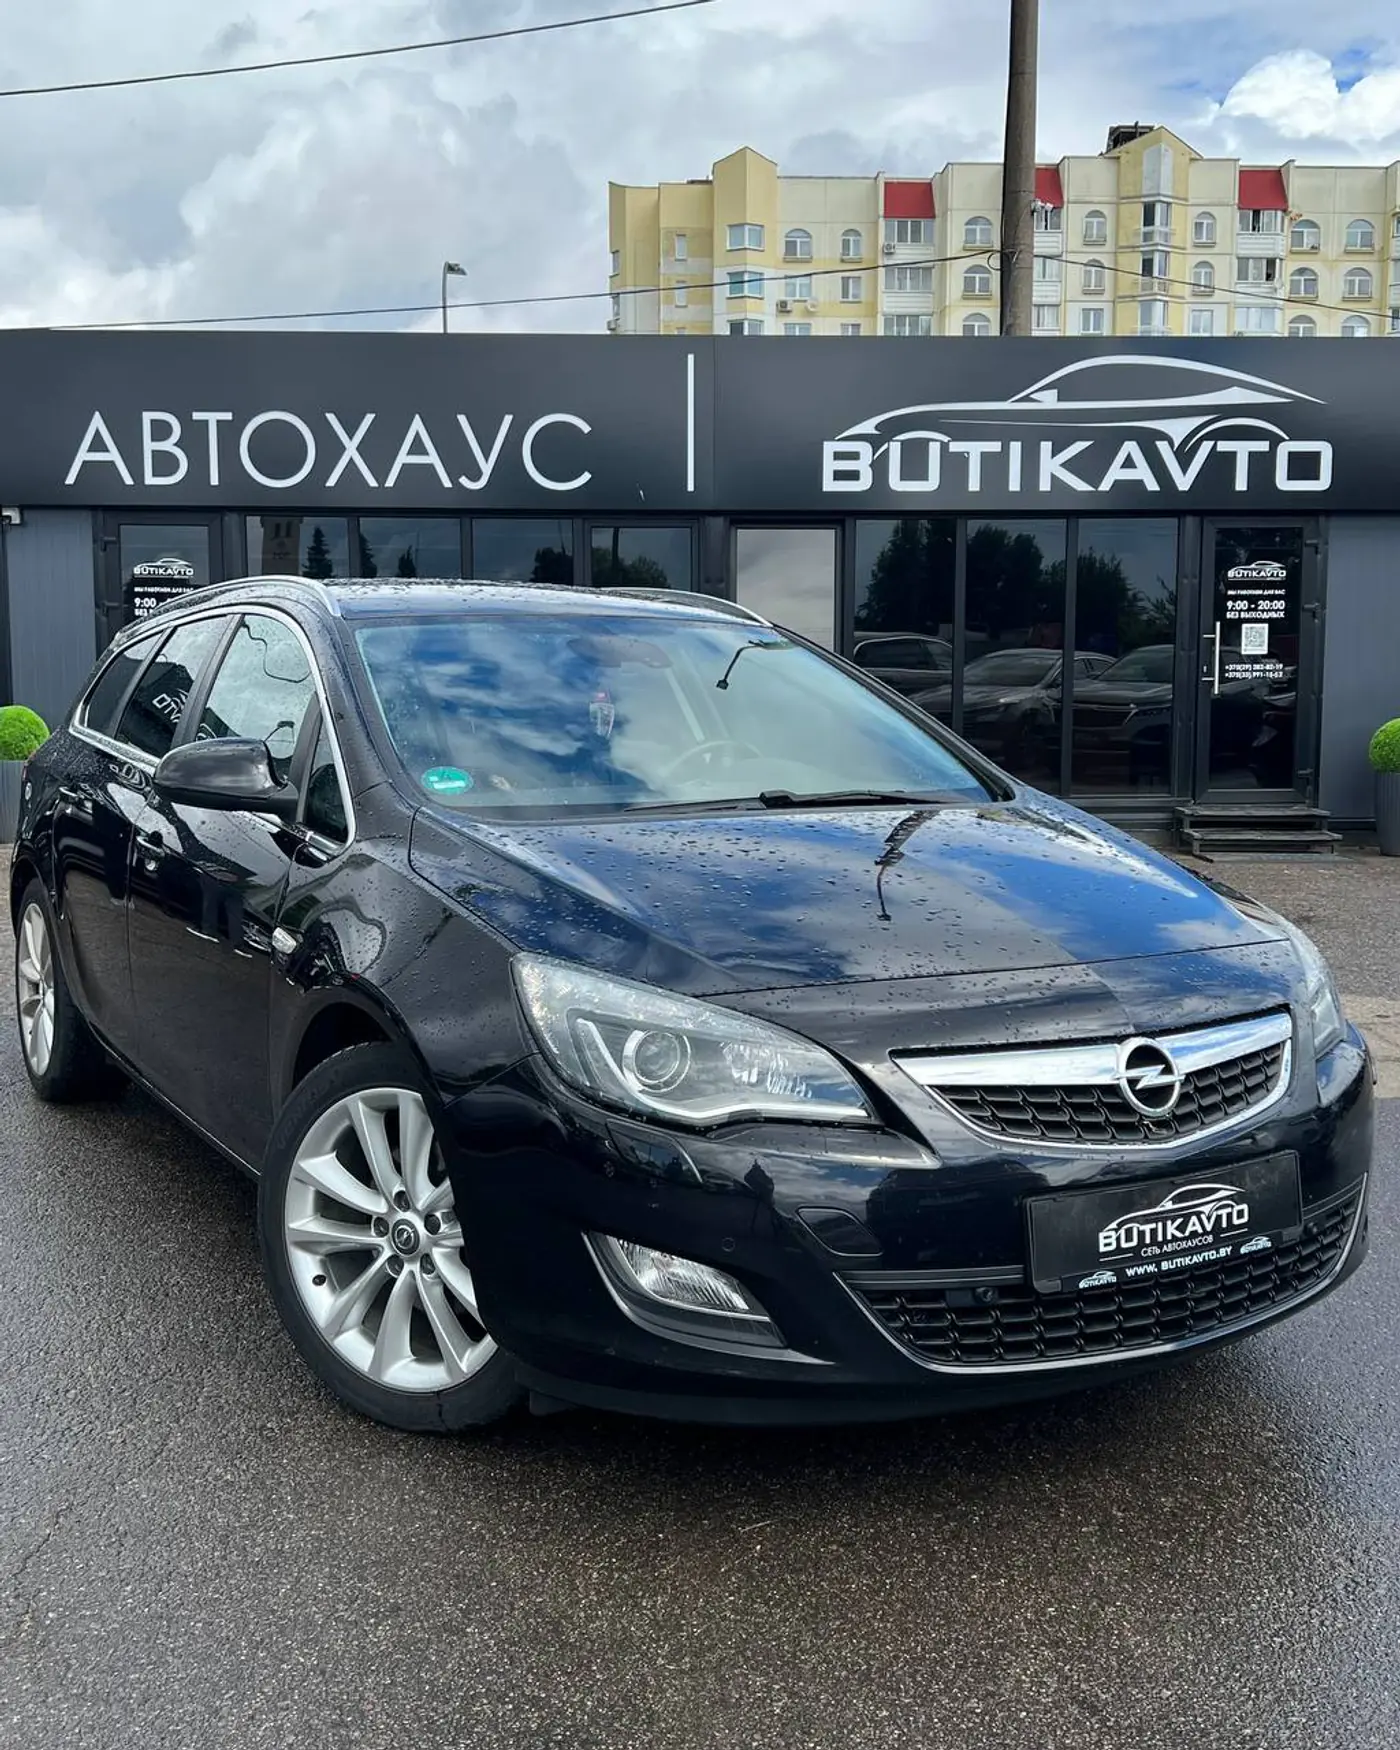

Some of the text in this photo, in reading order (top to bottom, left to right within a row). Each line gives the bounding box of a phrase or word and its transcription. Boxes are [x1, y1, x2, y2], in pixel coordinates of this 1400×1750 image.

[64, 410, 592, 491] АВТОХАУС
[822, 440, 1333, 492] BUTIKAVTO
[133, 567, 194, 576] BUTIKAVTO
[1227, 569, 1287, 578] BUTIKAVTO
[134, 597, 157, 608] 9:00
[1226, 600, 1248, 610] 9:00
[1257, 600, 1286, 610] 20:00
[1226, 611, 1239, 619] БЕЗ
[1098, 1203, 1249, 1253] BUTIKAVTO
[1141, 1234, 1214, 1257] СЕТЬ АВТОХАУСОВ
[1125, 1245, 1233, 1278] WWW. BUTIKAVTO.BY
